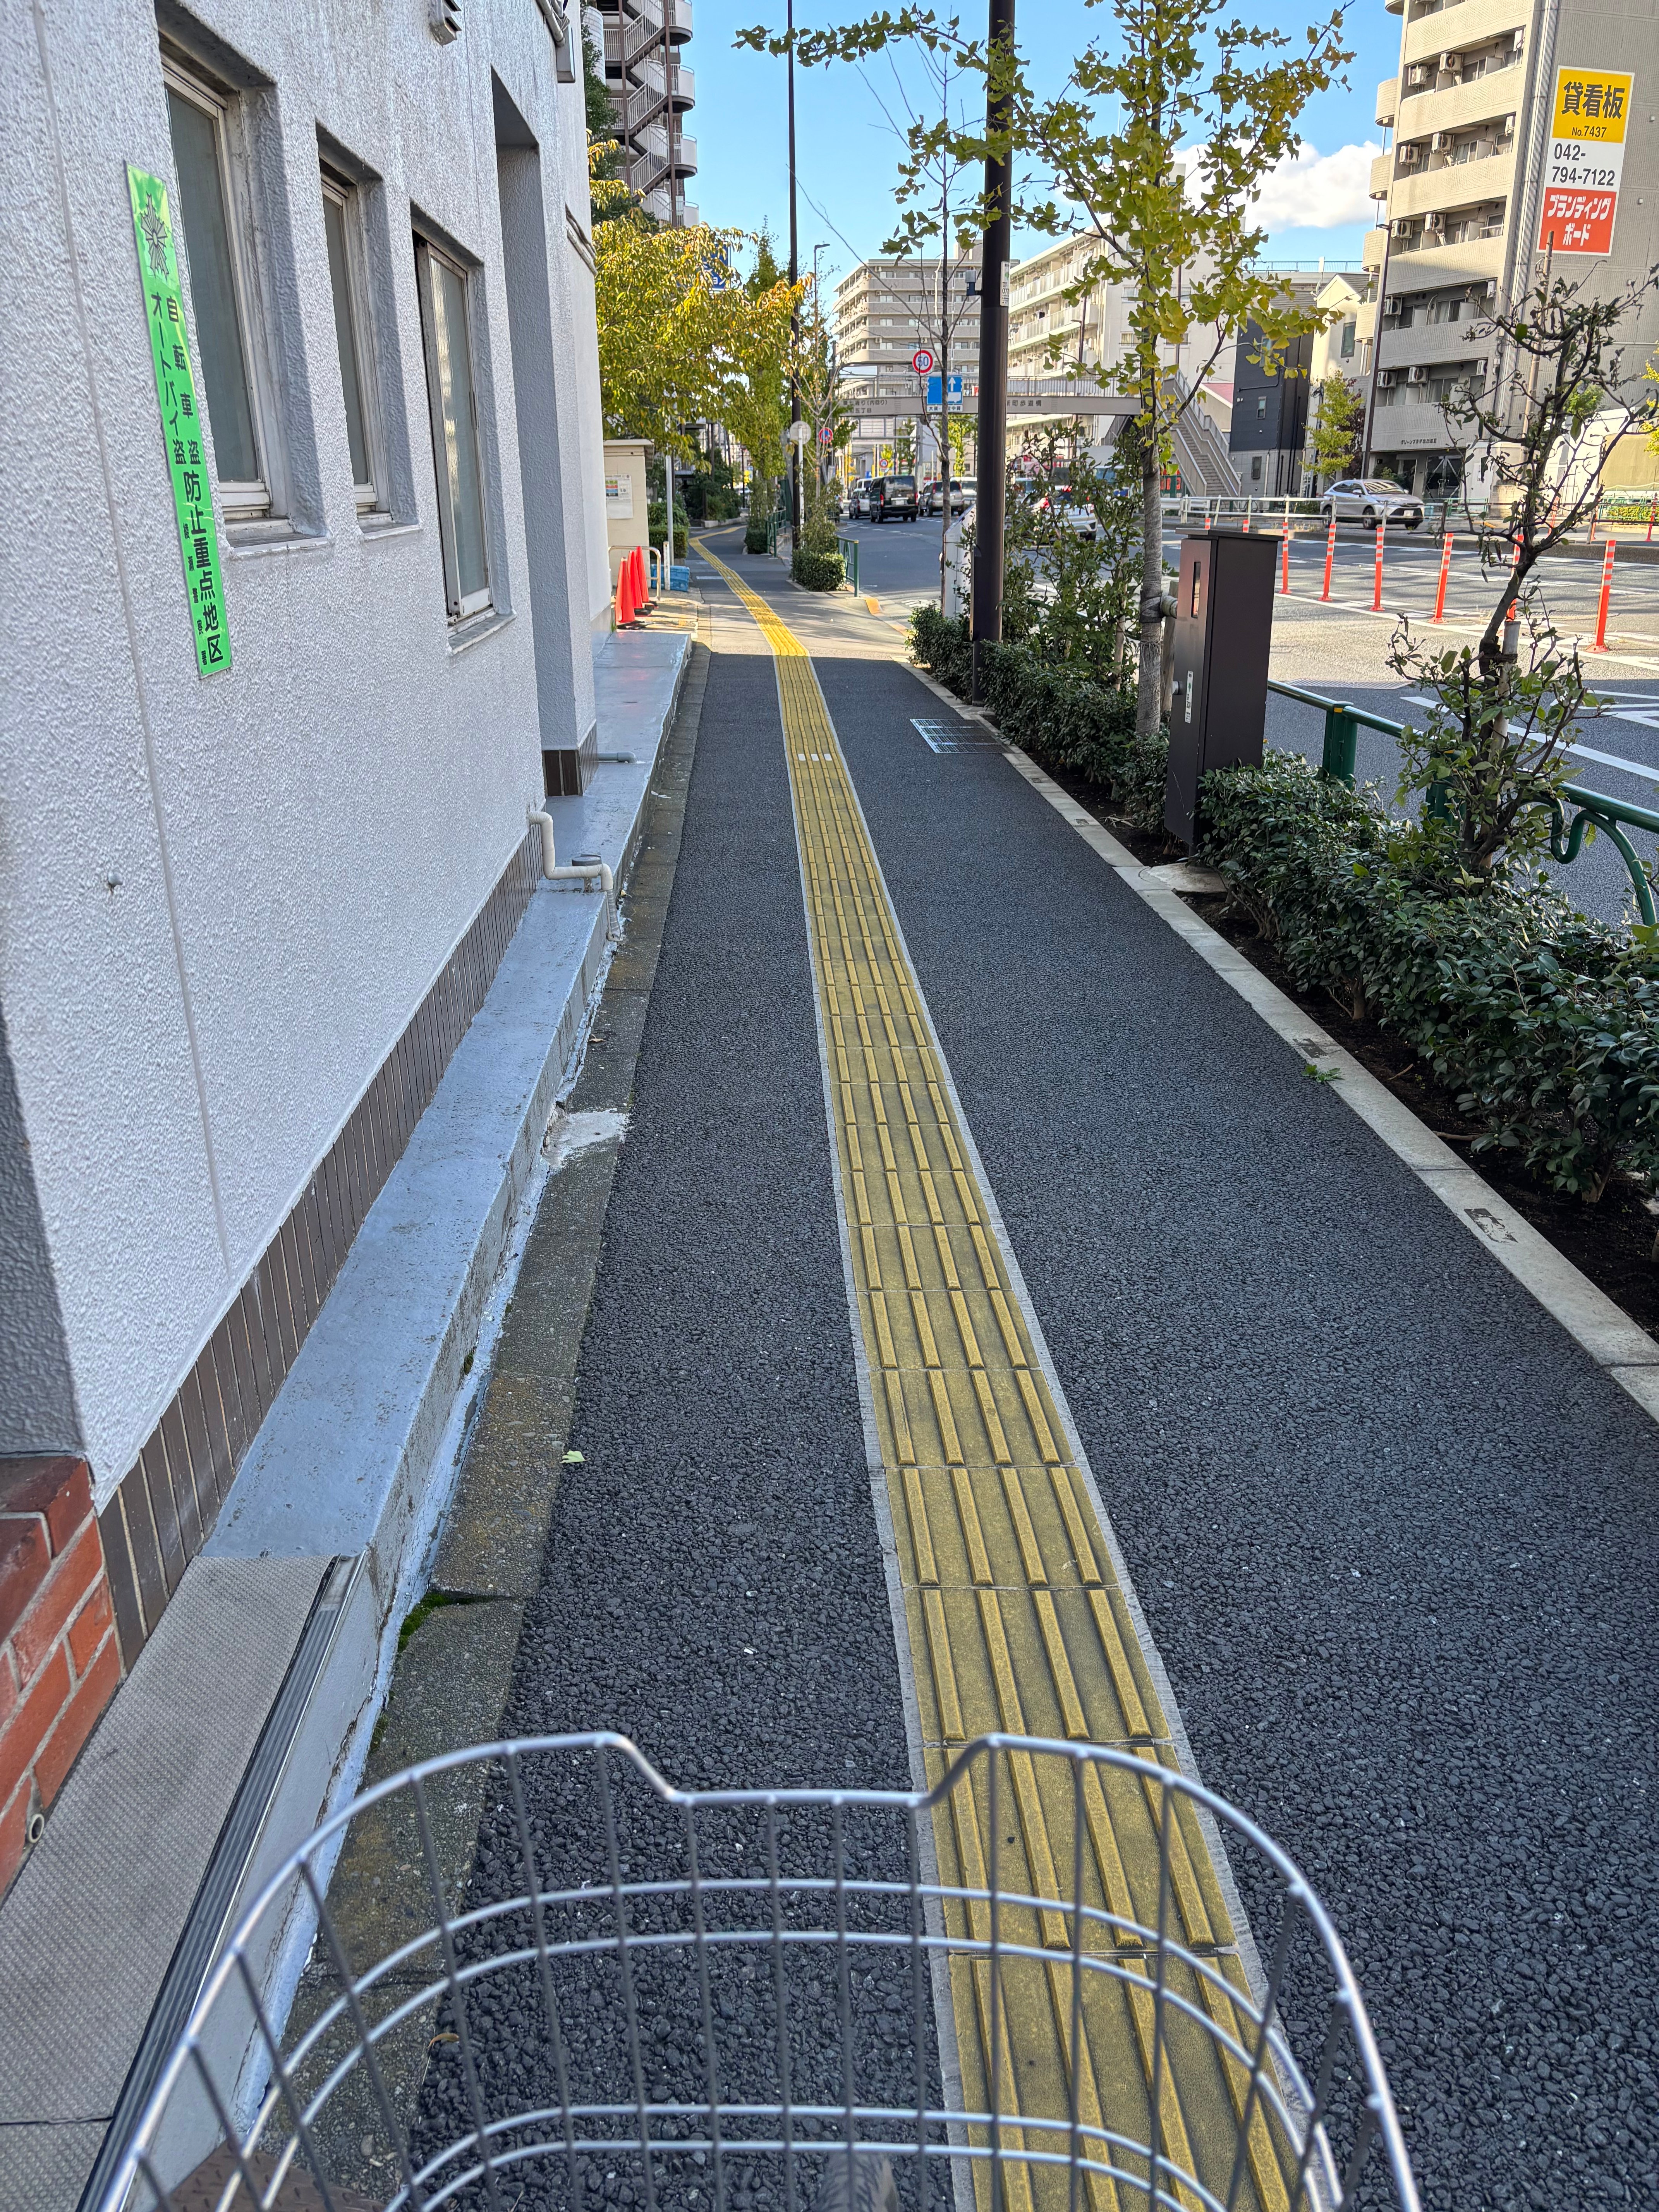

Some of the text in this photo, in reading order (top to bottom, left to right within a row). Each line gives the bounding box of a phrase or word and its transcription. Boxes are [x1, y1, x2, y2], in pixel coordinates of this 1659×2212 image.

[1561, 81, 1625, 120] 貸看板
[1571, 125, 1607, 138] No.7437
[1554, 143, 1586, 161] 042-
[1552, 167, 1616, 186] 794-7122
[1547, 194, 1611, 221] ブランディング
[1562, 223, 1591, 246] ボード
[917, 356, 929, 367] 50
[183, 470, 224, 663] 防止重点地区
